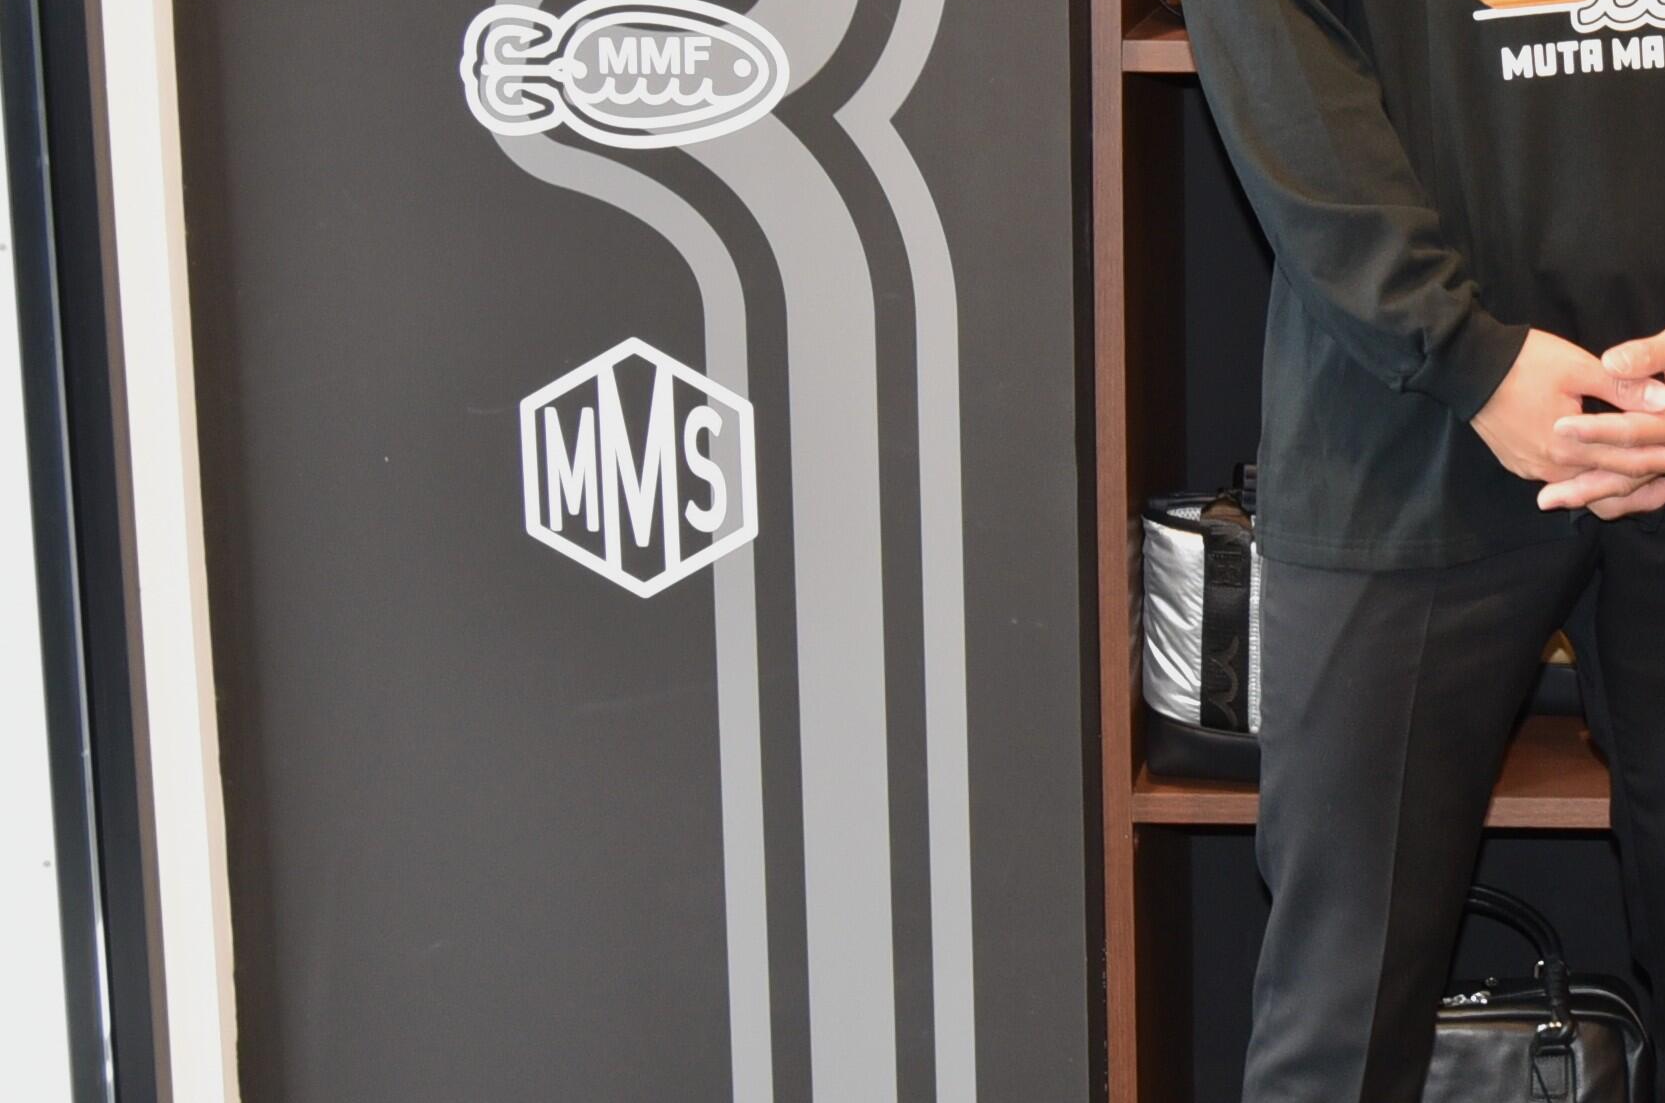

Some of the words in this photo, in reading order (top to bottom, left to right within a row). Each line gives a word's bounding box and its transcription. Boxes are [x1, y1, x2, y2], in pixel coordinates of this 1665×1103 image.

[598, 36, 713, 75] MMF
[1501, 39, 1603, 80] MUTA
[544, 360, 728, 571] MMS
